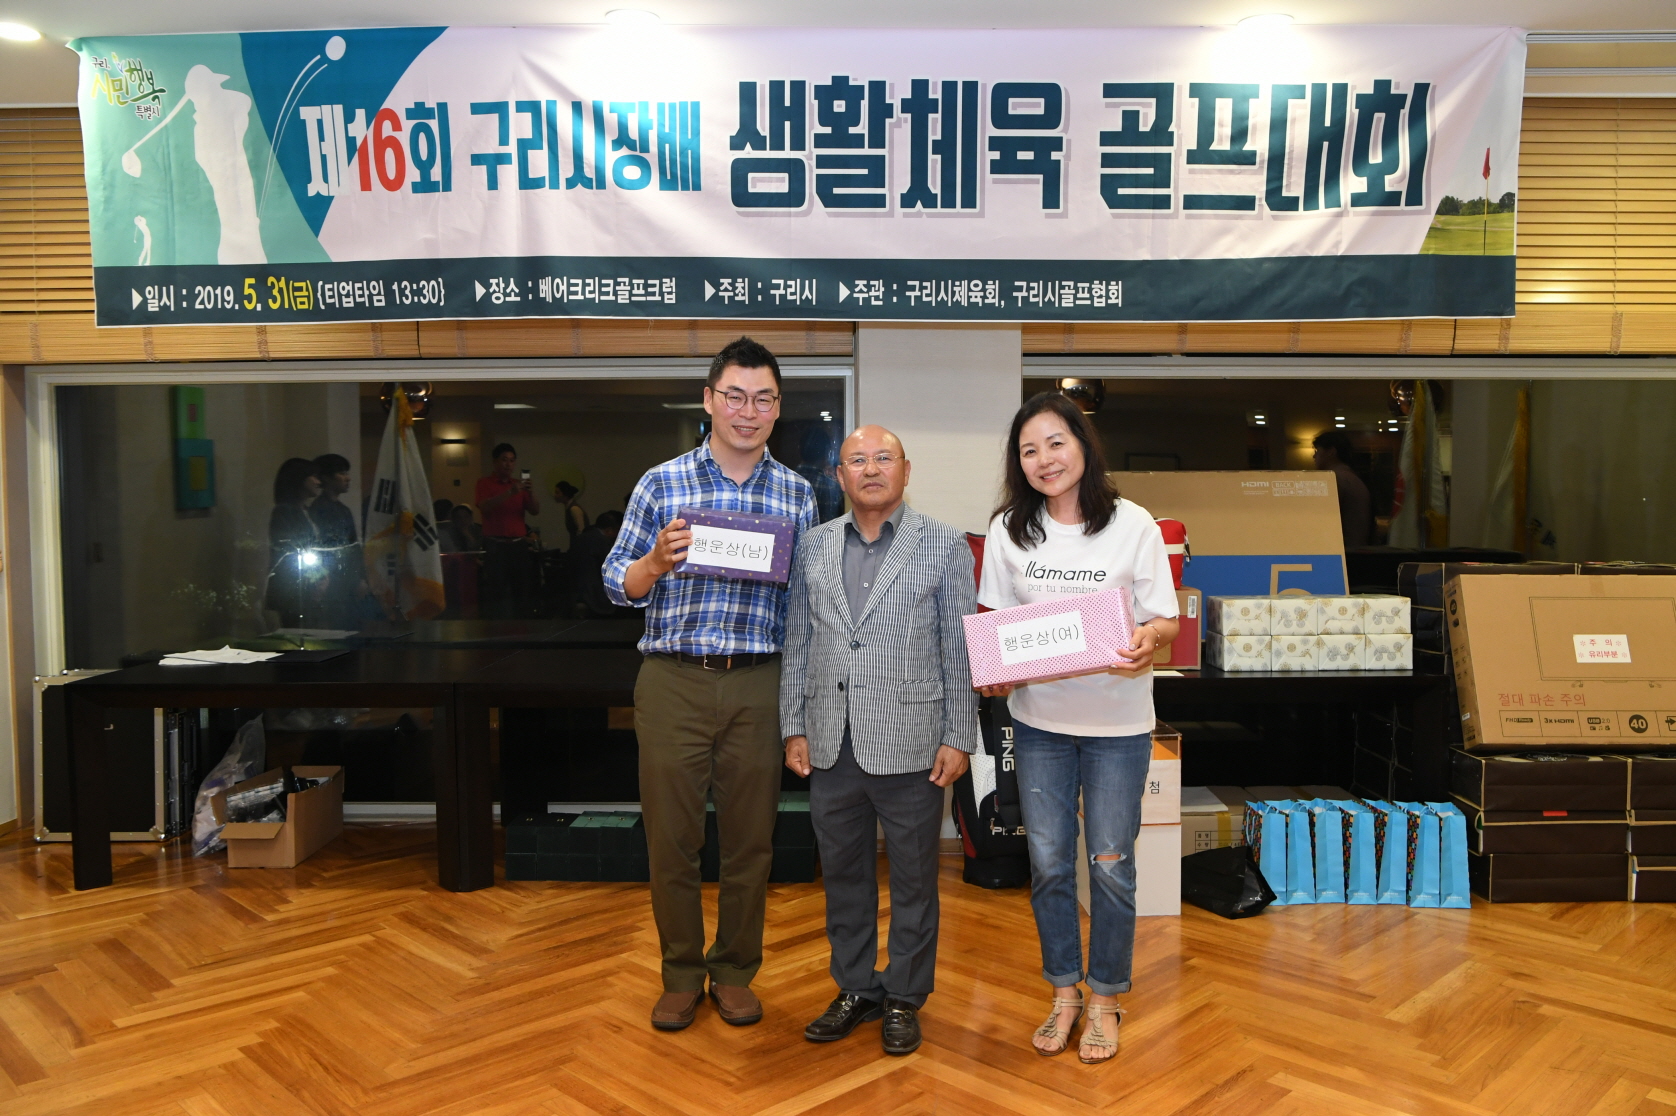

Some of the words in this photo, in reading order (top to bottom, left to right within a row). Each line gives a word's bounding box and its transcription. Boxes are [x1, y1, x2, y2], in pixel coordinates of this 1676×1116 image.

[136, 105, 160, 120] 특별시
[299, 101, 453, 197] 제16회
[470, 99, 701, 192] 구리시장배
[729, 75, 1064, 211] 생활체육
[1099, 78, 1431, 212] 골프대회
[145, 285, 175, 311] 일시
[194, 285, 239, 310] 2019.
[243, 277, 262, 311] 5.
[267, 276, 314, 311] 31(금)
[488, 276, 521, 305] 장소
[539, 276, 677, 304] 베어크리크골프크럽
[718, 277, 749, 305] 주최
[769, 278, 817, 305] 구리시
[853, 278, 885, 306] 주관
[905, 279, 1005, 308] 구리시체육회,
[1012, 280, 1123, 307] 구리시골프협회
[694, 537, 769, 561] 행운상(남)
[1025, 560, 1107, 583] llámame
[1027, 583, 1042, 593] por
[1046, 584, 1056, 593] tu
[1060, 584, 1098, 594] nombre
[1003, 623, 1079, 652] 행운상(여)
[1588, 650, 1619, 658] 유리부분
[1498, 693, 1525, 708] 절대
[1529, 693, 1555, 707] 파손
[1560, 693, 1586, 707] 주의
[1630, 718, 1646, 729] 40
[1001, 726, 1015, 772] PING
[991, 826, 1027, 836] PIG
